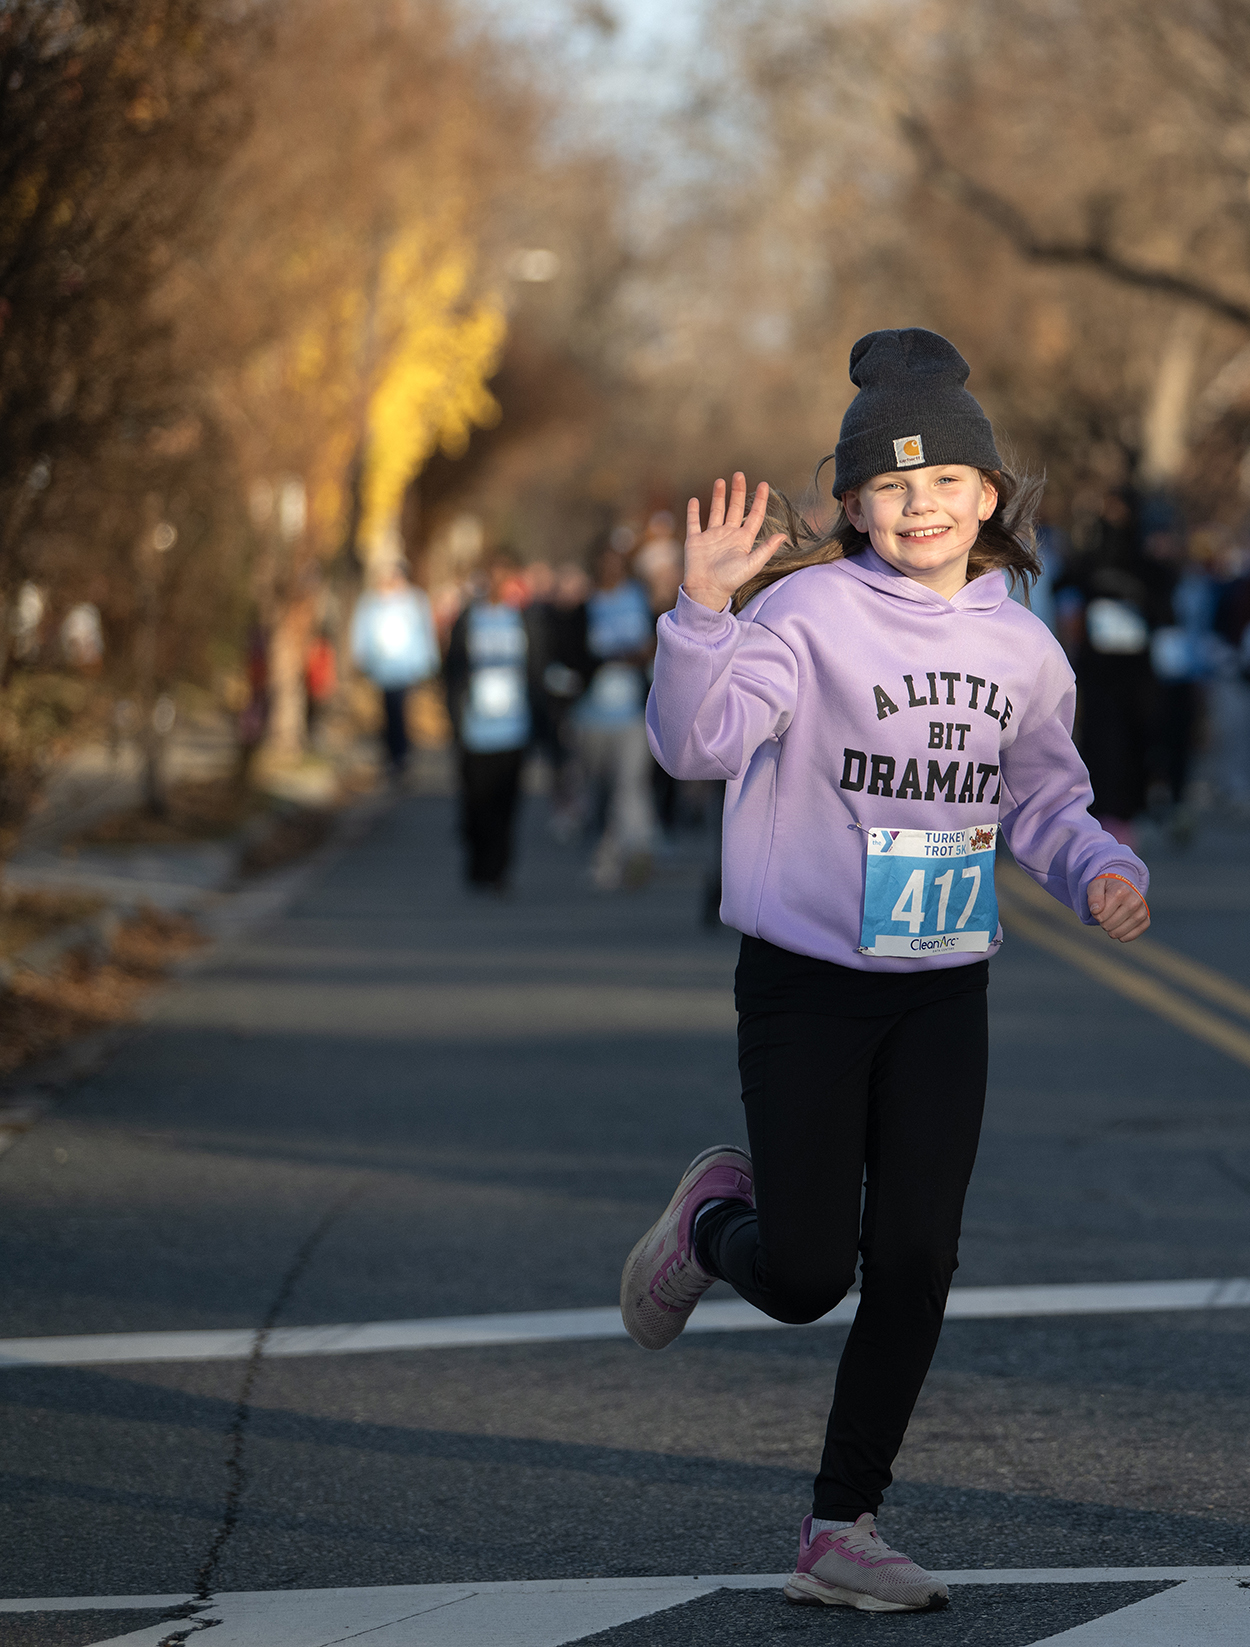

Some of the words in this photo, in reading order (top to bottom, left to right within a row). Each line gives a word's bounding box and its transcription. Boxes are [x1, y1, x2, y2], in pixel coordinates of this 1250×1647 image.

[872, 684, 900, 721] A
[902, 671, 1013, 732] LITTLE
[928, 721, 971, 751] BIT
[839, 747, 1000, 805] DRAMAT
[924, 845, 954, 856] TROT
[955, 845, 967, 856] 5K
[925, 831, 966, 844] TURKEY
[891, 865, 982, 934] 417
[910, 935, 956, 951] CleanArc
